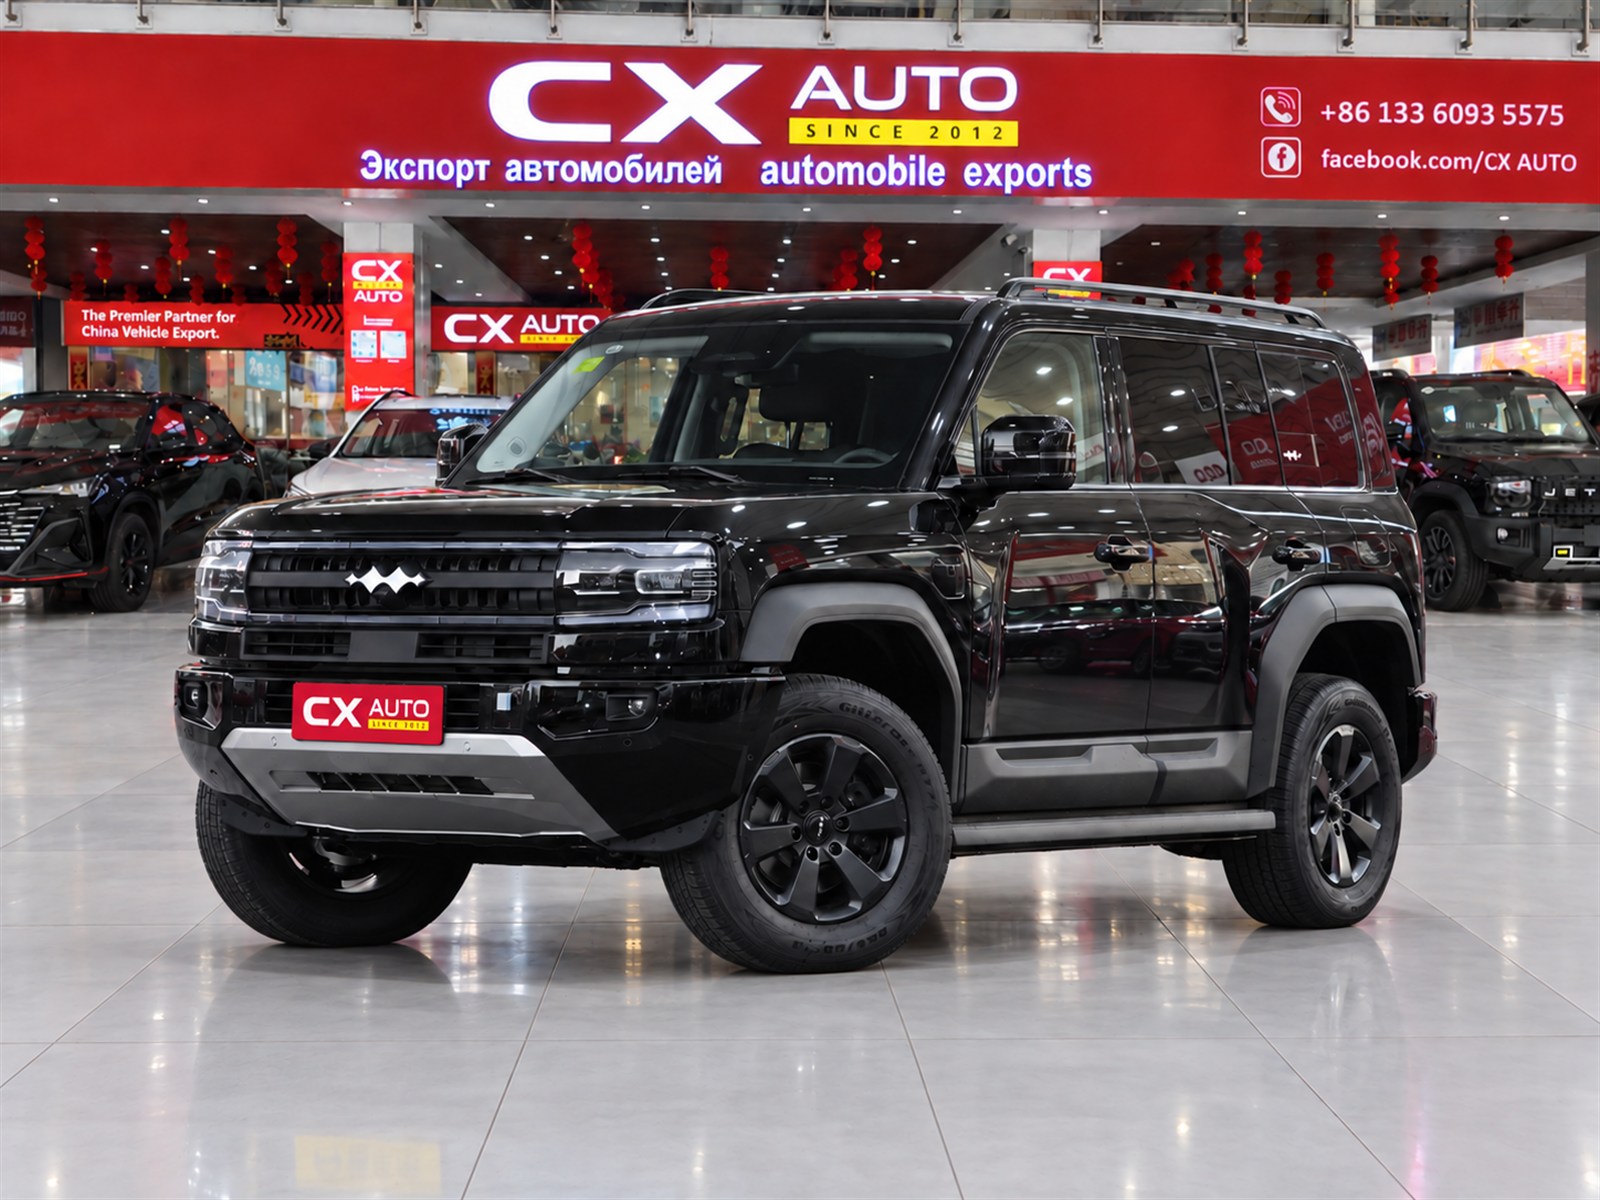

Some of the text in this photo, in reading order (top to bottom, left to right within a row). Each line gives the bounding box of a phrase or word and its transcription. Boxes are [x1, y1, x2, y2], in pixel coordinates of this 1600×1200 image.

[488, 60, 1018, 146] CX AUTO
[1320, 101, 1565, 126] +86 133 6093 5575
[805, 123, 1005, 141] SINCE 2012
[360, 149, 723, 189] Экспорт автомобилей
[760, 153, 1094, 194] automobile exports
[1321, 148, 1577, 174] facebook.com/CX AUTO
[351, 259, 403, 282] CX
[353, 290, 403, 303] AUTO
[81, 309, 237, 323] The Premier Partner for
[443, 313, 599, 344] CX AUTO
[81, 325, 220, 342] China Vehicle Export.
[303, 696, 430, 728] CX AUTO
